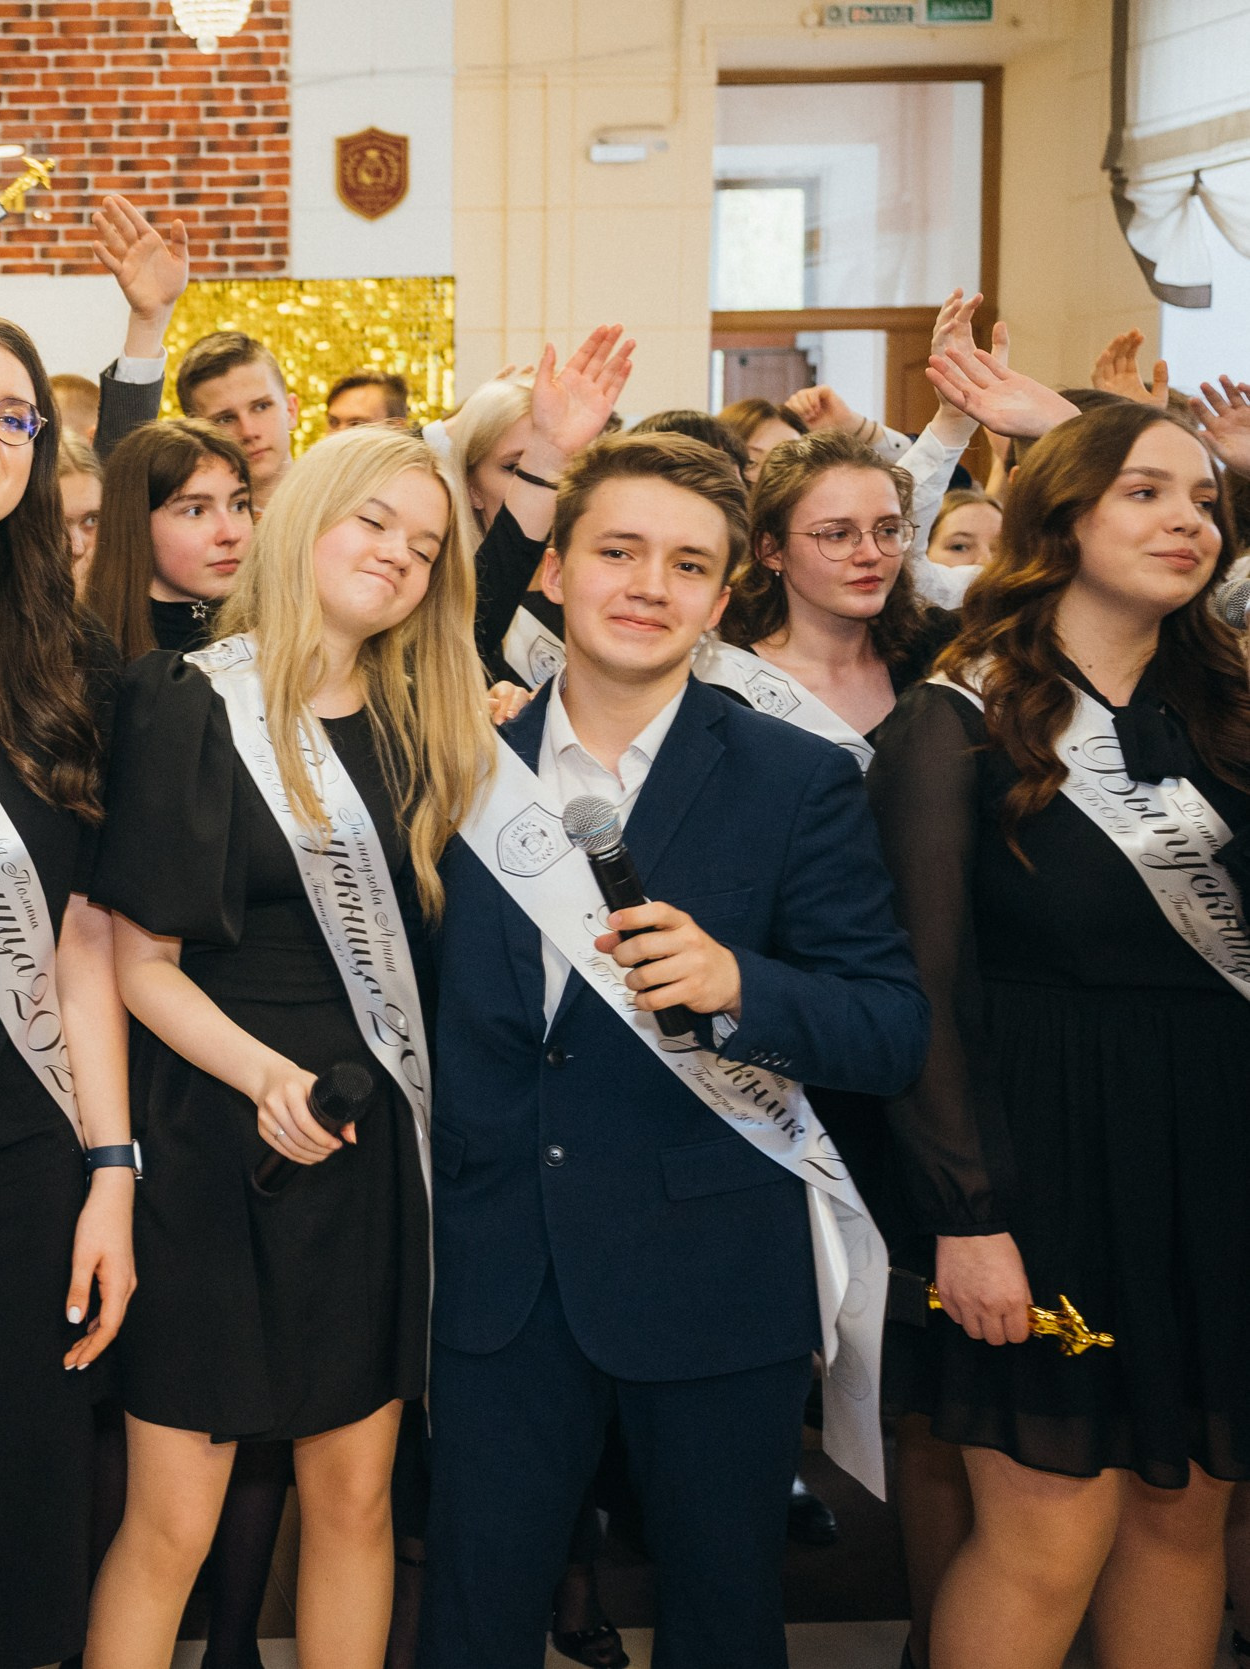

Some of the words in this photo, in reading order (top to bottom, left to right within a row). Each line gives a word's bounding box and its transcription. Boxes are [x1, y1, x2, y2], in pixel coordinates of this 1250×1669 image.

[1069, 774, 1135, 837] МБОУ
[0, 862, 40, 930] Полина
[338, 807, 384, 906] Галигузова
[373, 912, 396, 973] Арина
[6, 972, 80, 1123] 202
